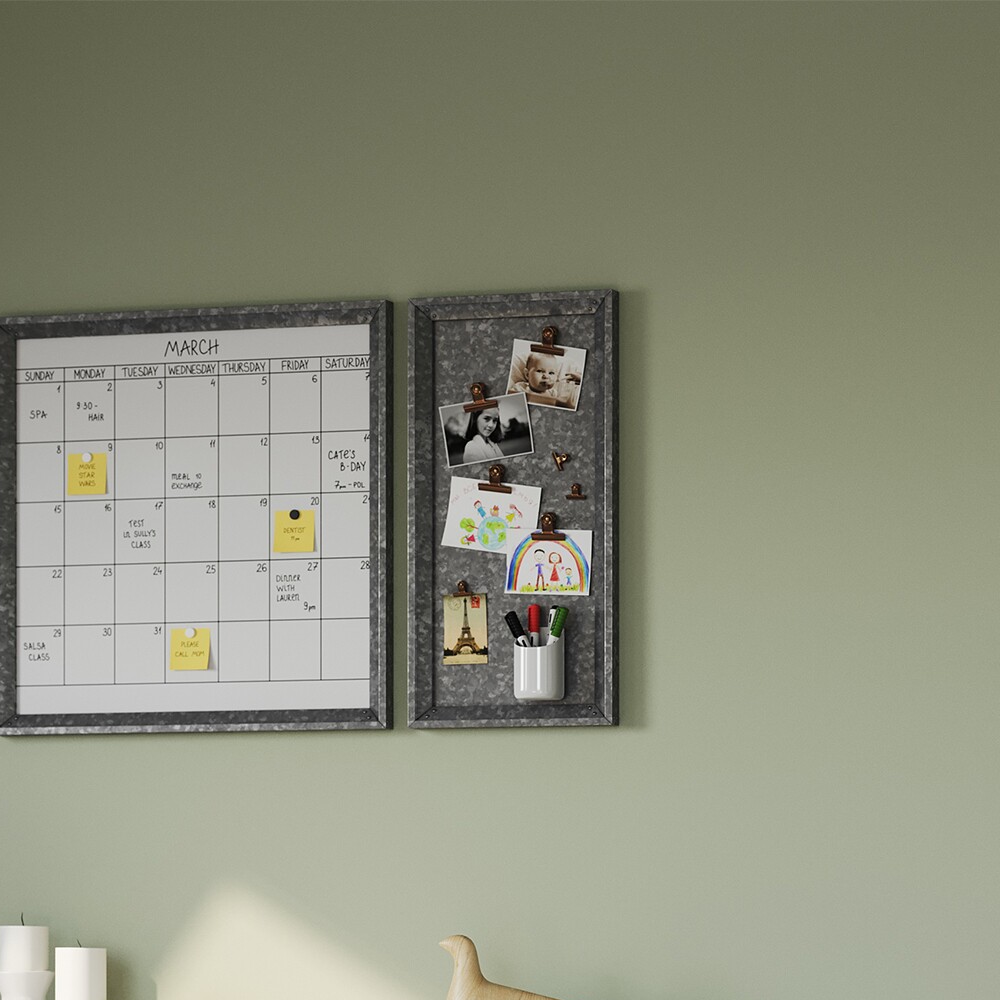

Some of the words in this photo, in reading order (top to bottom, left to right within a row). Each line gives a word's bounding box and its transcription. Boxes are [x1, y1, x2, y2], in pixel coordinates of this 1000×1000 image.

[164, 339, 219, 357] MARCH
[25, 371, 54, 381] SUNDAY
[73, 368, 106, 379] MONDAY
[121, 366, 159, 377] TUESDAY
[168, 364, 216, 375] WEDNESDAY
[222, 362, 266, 373] THURSDAY
[281, 359, 310, 371] FRIDAY
[325, 357, 370, 369] SATURDAY
[56, 385, 61, 393] 1
[107, 382, 113, 392] 2
[157, 381, 163, 389] 3
[210, 379, 216, 387] 4
[261, 376, 267, 386] 5
[312, 374, 318, 383] 6
[29, 410, 48, 419] SPA
[88, 413, 104, 421] HAIR
[56, 446, 62, 454] 8
[108, 443, 113, 451] 9
[155, 442, 164, 450] 10
[210, 440, 216, 448] 11
[260, 438, 268, 447] 12
[312, 435, 320, 444] 13
[54, 504, 62, 514] 15
[104, 504, 112, 512] 16
[154, 501, 164, 510] 17
[208, 500, 216, 509] 18
[260, 498, 268, 507] 19
[310, 497, 320, 506] 20
[131, 541, 151, 549] CLASS
[52, 569, 63, 579] 22
[102, 568, 113, 577] 23
[152, 566, 162, 576] 24
[206, 565, 216, 574] 25
[256, 563, 267, 572] 26
[307, 562, 319, 572] 27
[360, 560, 370, 570] 28
[53, 629, 62, 637] 29
[102, 627, 112, 637] 30
[154, 626, 162, 635] 31
[23, 642, 46, 651] SALSA
[28, 653, 50, 661] CLASS
